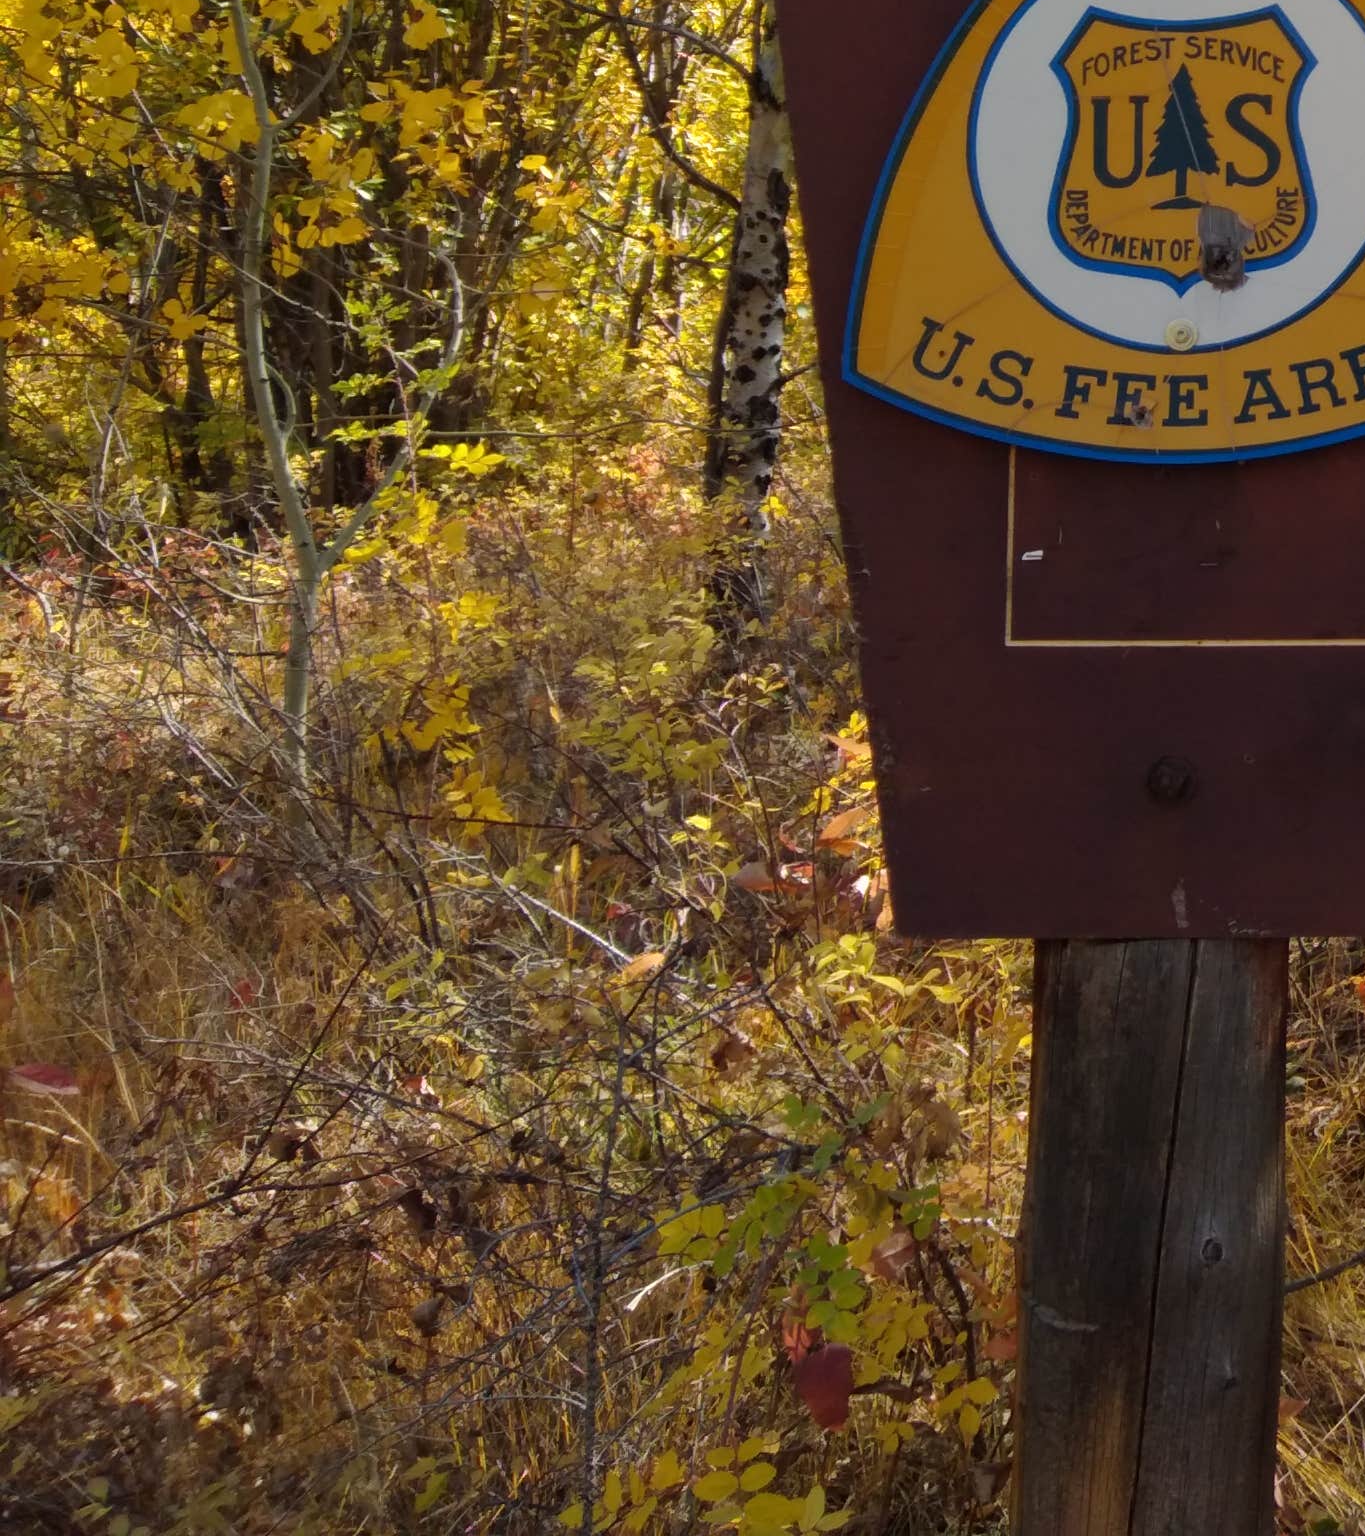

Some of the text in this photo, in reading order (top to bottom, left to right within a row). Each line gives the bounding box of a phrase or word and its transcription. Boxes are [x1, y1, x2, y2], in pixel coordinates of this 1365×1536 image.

[1081, 36, 1285, 87] FOREST SERVICE
[1091, 93, 1281, 189] U S
[1065, 189, 1167, 262] DEPARTMENT
[1170, 238, 1195, 262] OF
[912, 318, 1034, 410] U.S.
[1055, 365, 1208, 427] FEE
